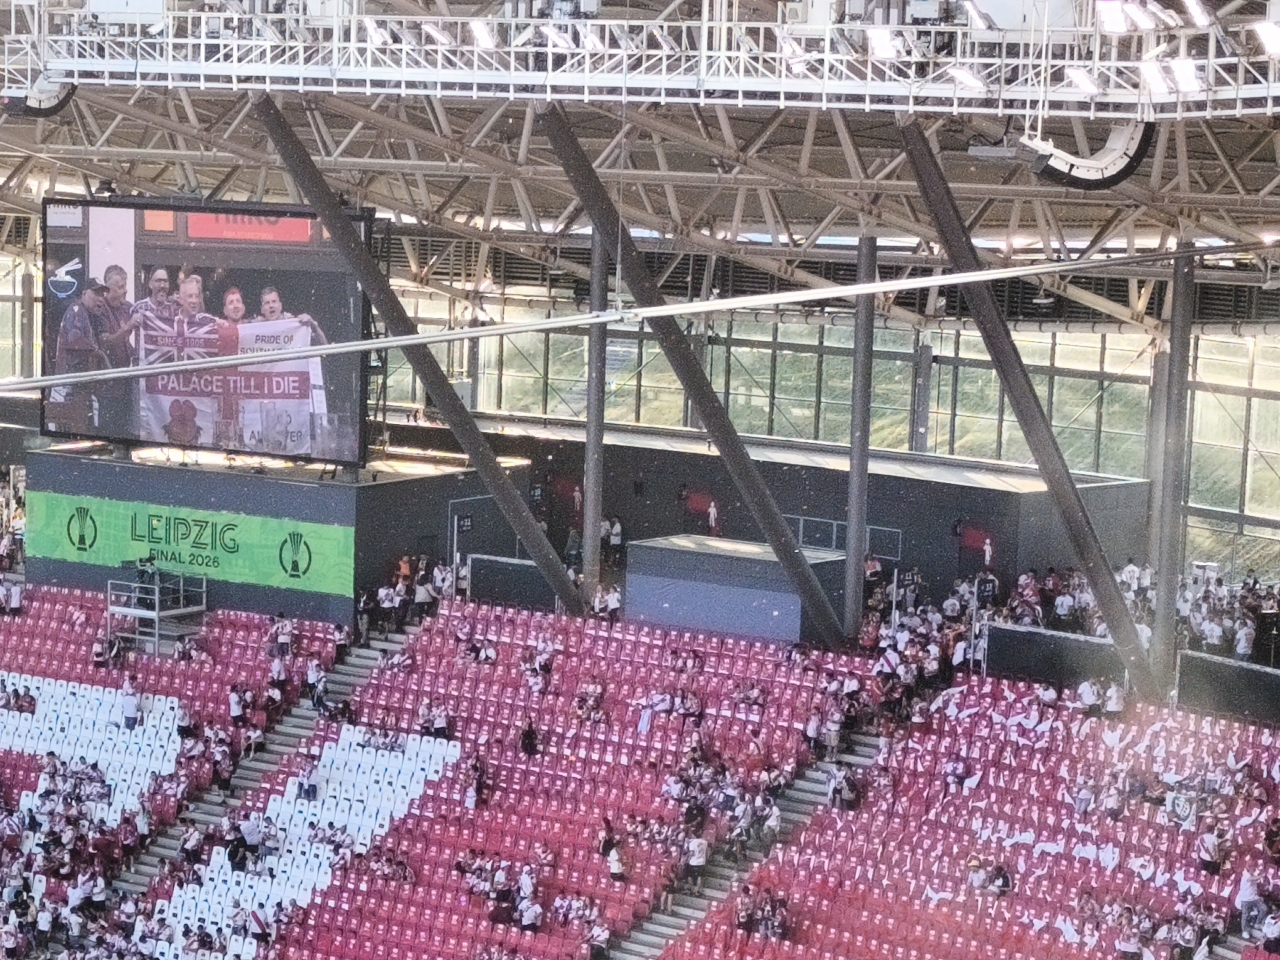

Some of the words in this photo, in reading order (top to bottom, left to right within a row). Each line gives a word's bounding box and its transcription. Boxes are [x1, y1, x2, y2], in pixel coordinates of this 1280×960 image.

[255, 335, 280, 344] PRIDE
[157, 374, 223, 393] PALACE
[227, 376, 260, 394] TILL
[273, 376, 300, 395] DIE
[130, 512, 240, 554] LEIPZIG
[149, 548, 185, 564] FINAL
[188, 552, 220, 568] 2026
